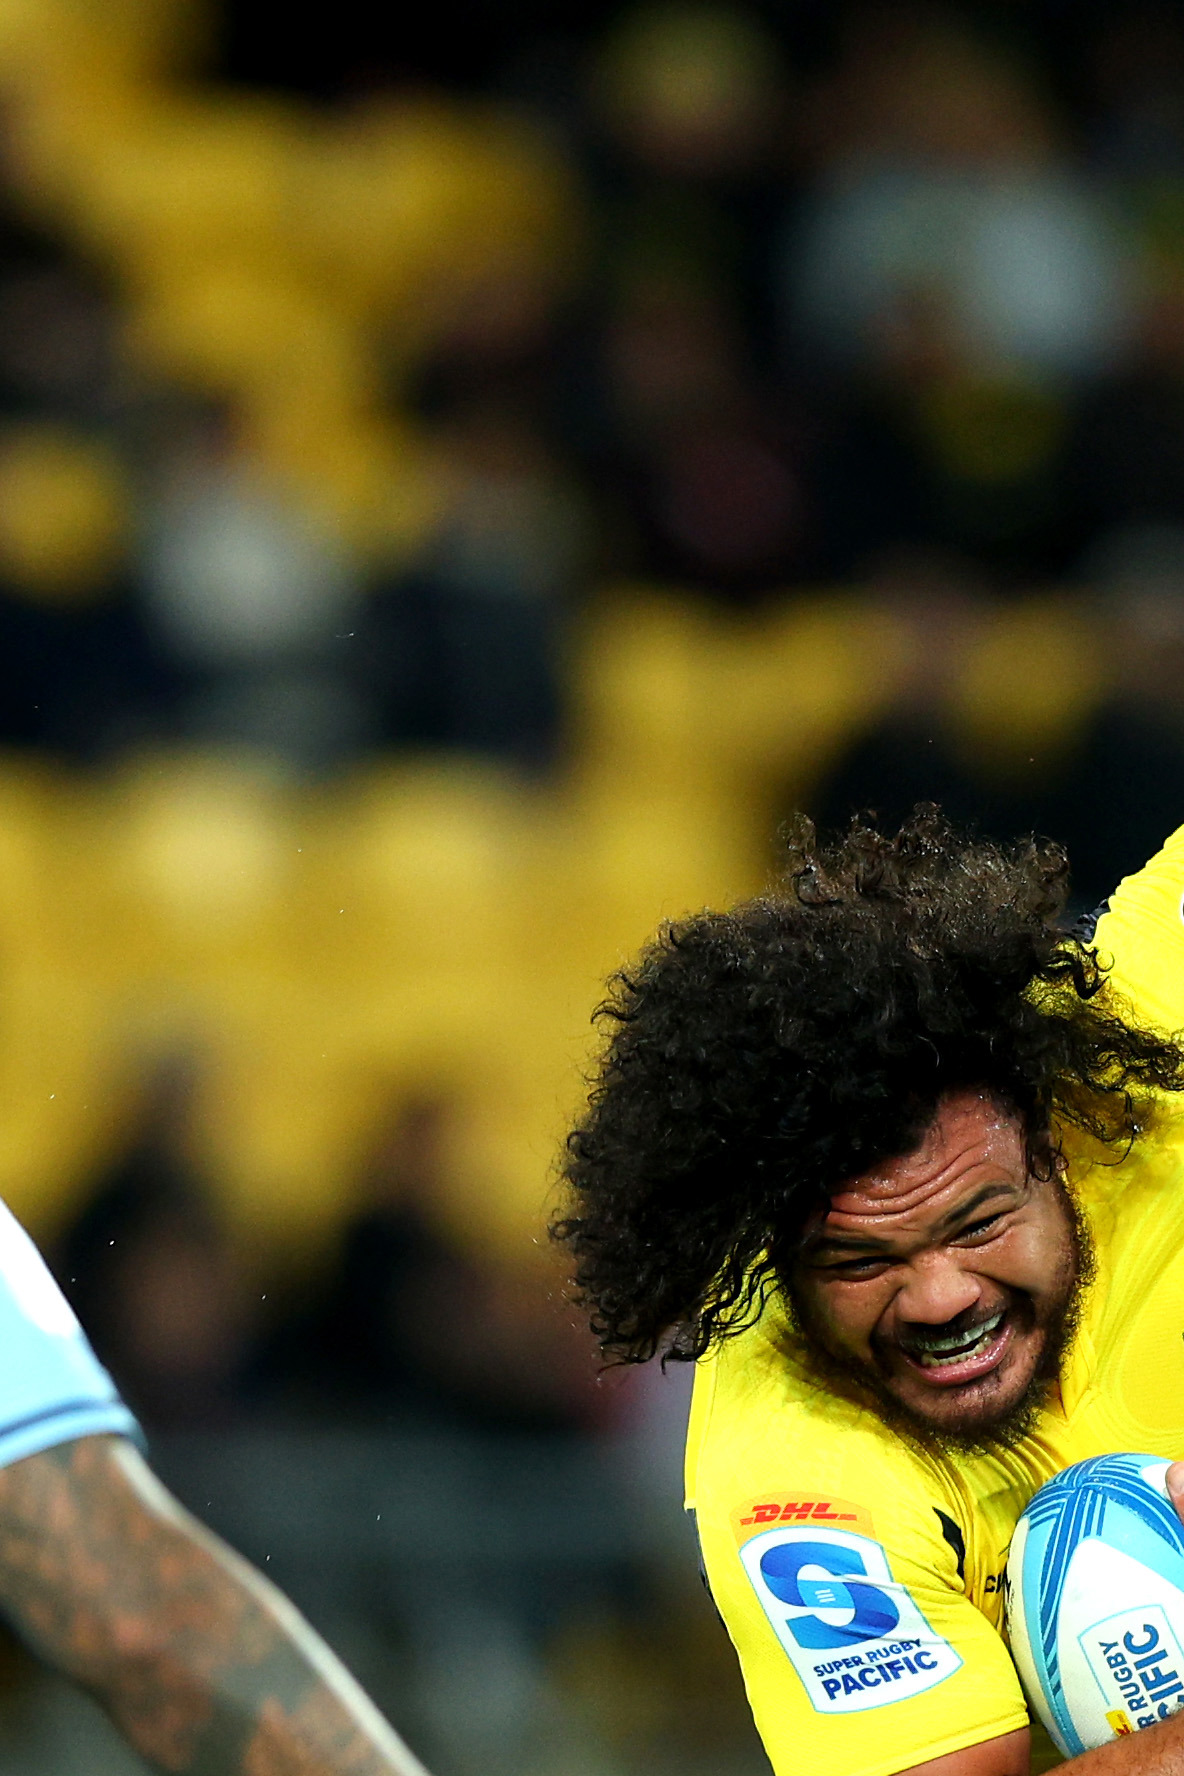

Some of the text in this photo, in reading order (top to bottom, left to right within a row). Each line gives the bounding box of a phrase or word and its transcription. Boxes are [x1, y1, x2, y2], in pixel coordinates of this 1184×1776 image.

[746, 1502, 852, 1525] DHL
[813, 1638, 922, 1677] SUPER RUGBY
[822, 1651, 938, 1700] PACIFIC
[1098, 1641, 1149, 1712] RUGBY
